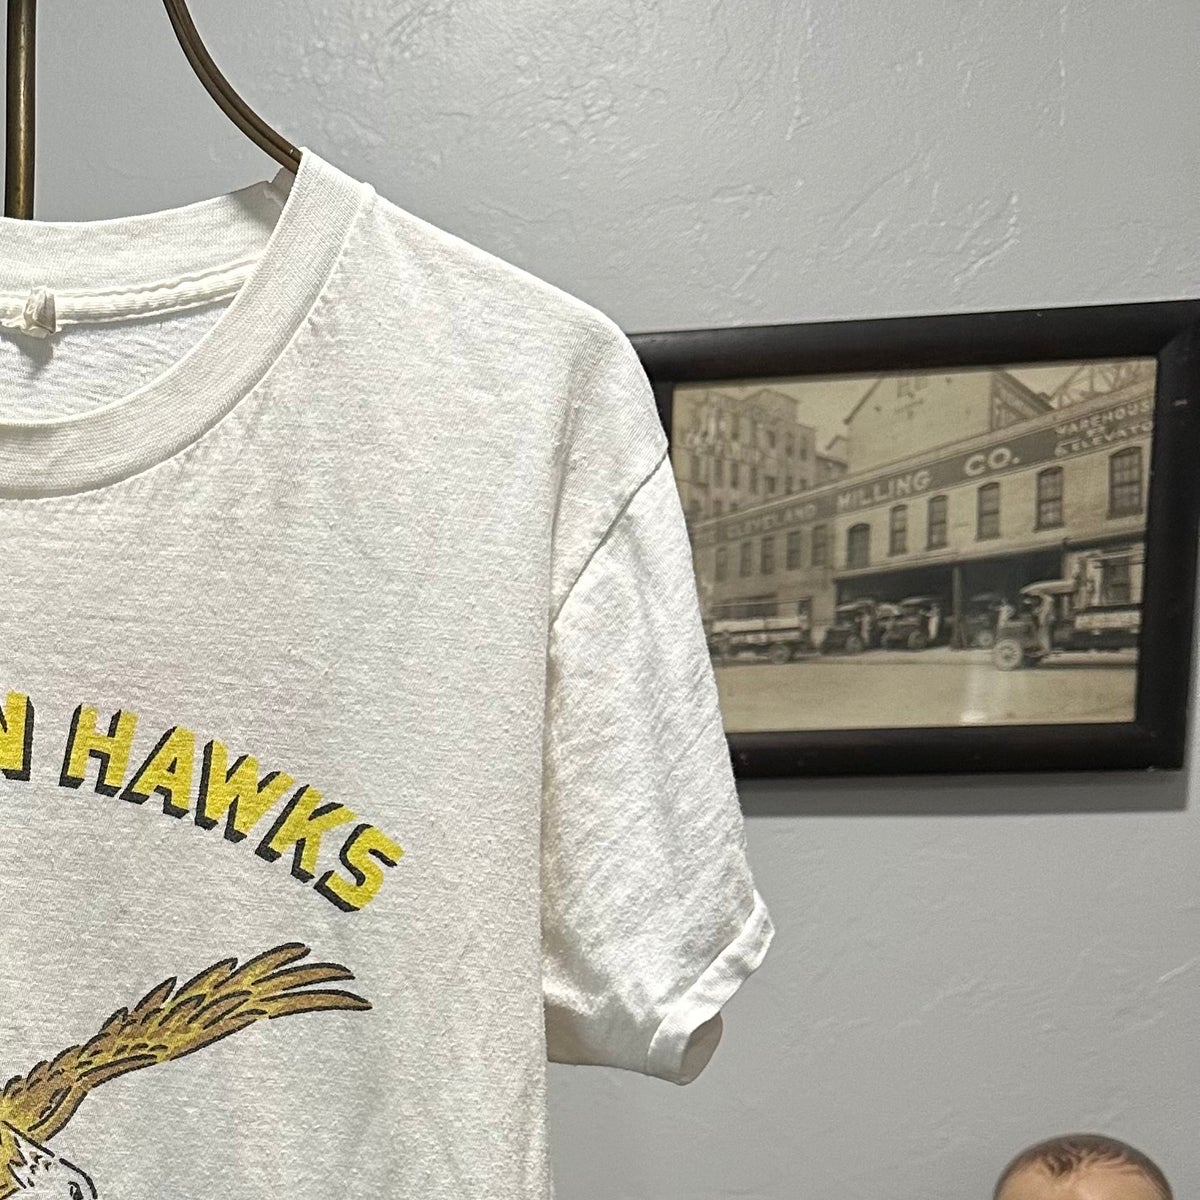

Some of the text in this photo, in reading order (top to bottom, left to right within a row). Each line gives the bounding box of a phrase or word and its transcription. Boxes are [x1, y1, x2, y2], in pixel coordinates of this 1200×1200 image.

[836, 470, 931, 510] MILLING
[963, 447, 1021, 477] CO.
[58, 701, 405, 912] HAWKS
